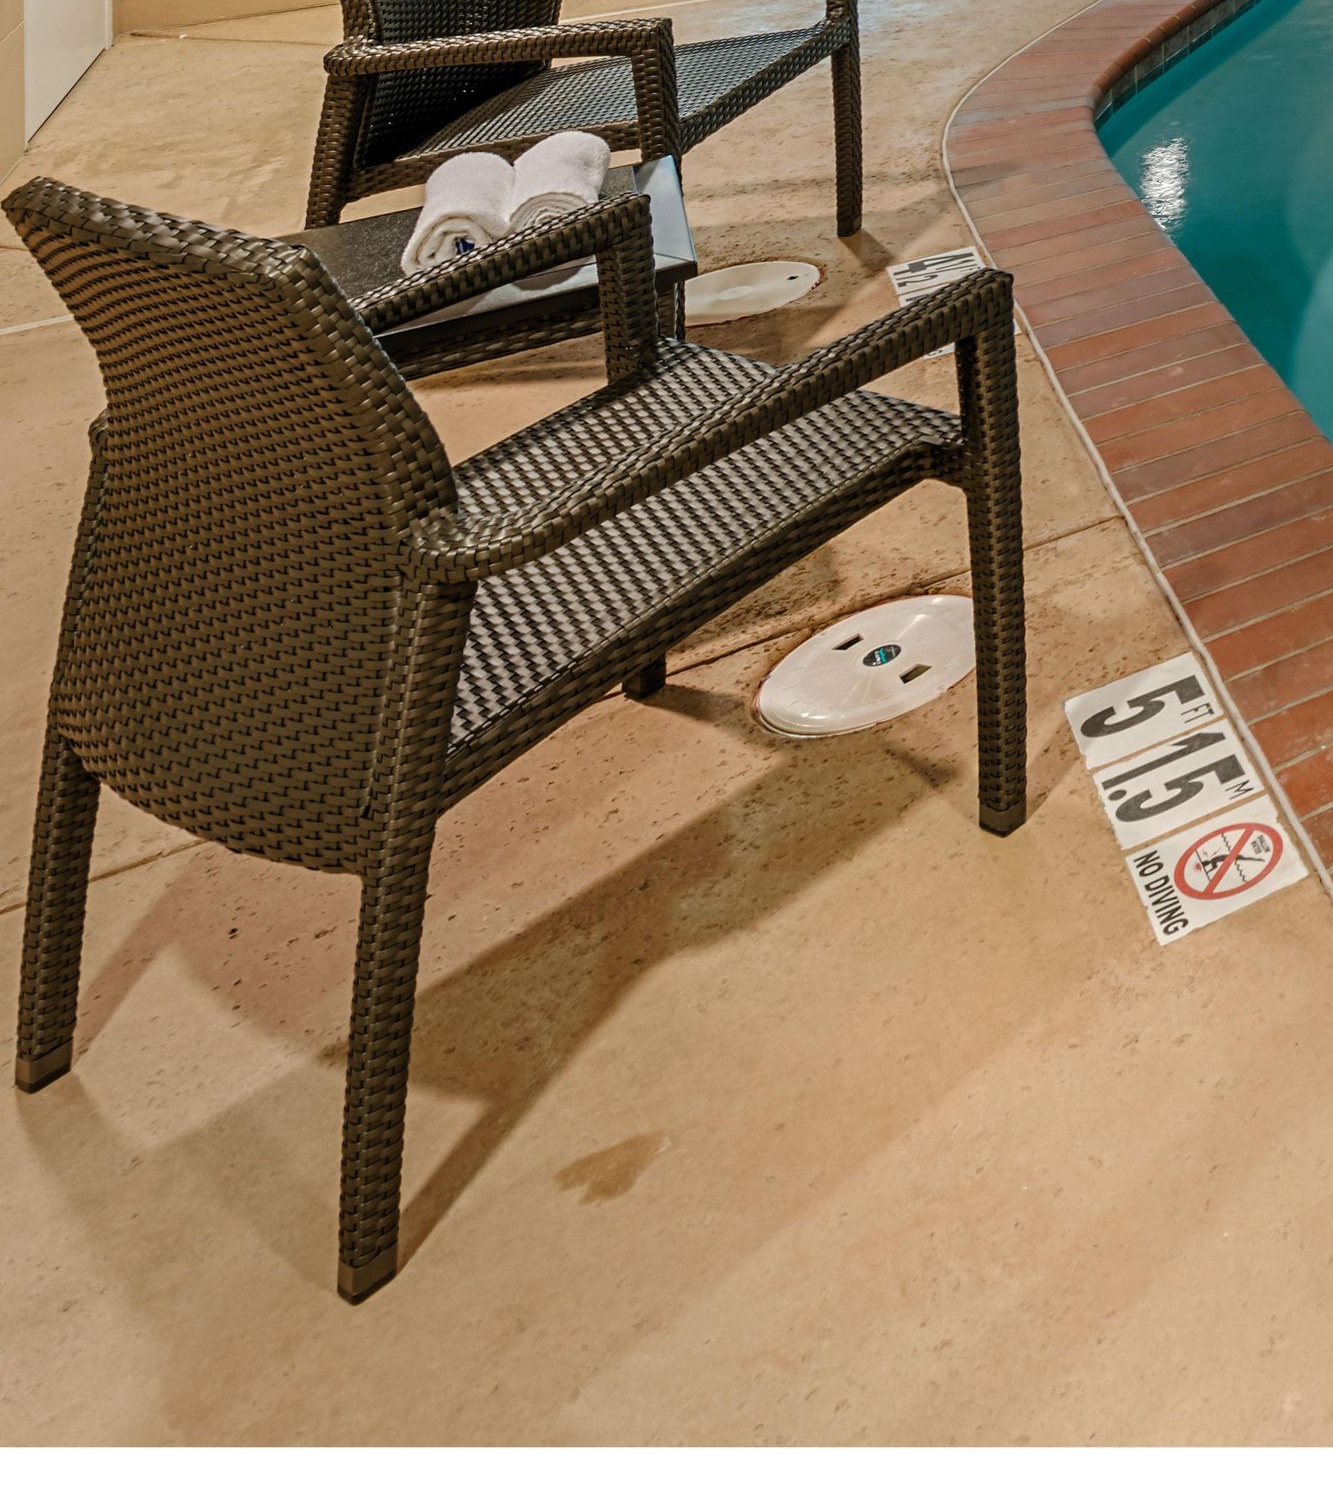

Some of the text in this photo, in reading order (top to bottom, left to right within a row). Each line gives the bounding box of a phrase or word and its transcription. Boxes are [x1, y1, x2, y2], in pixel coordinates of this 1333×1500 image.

[1080, 675, 1254, 823] 5 FT 1.5 M
[1133, 850, 1190, 936] NO DIVING
